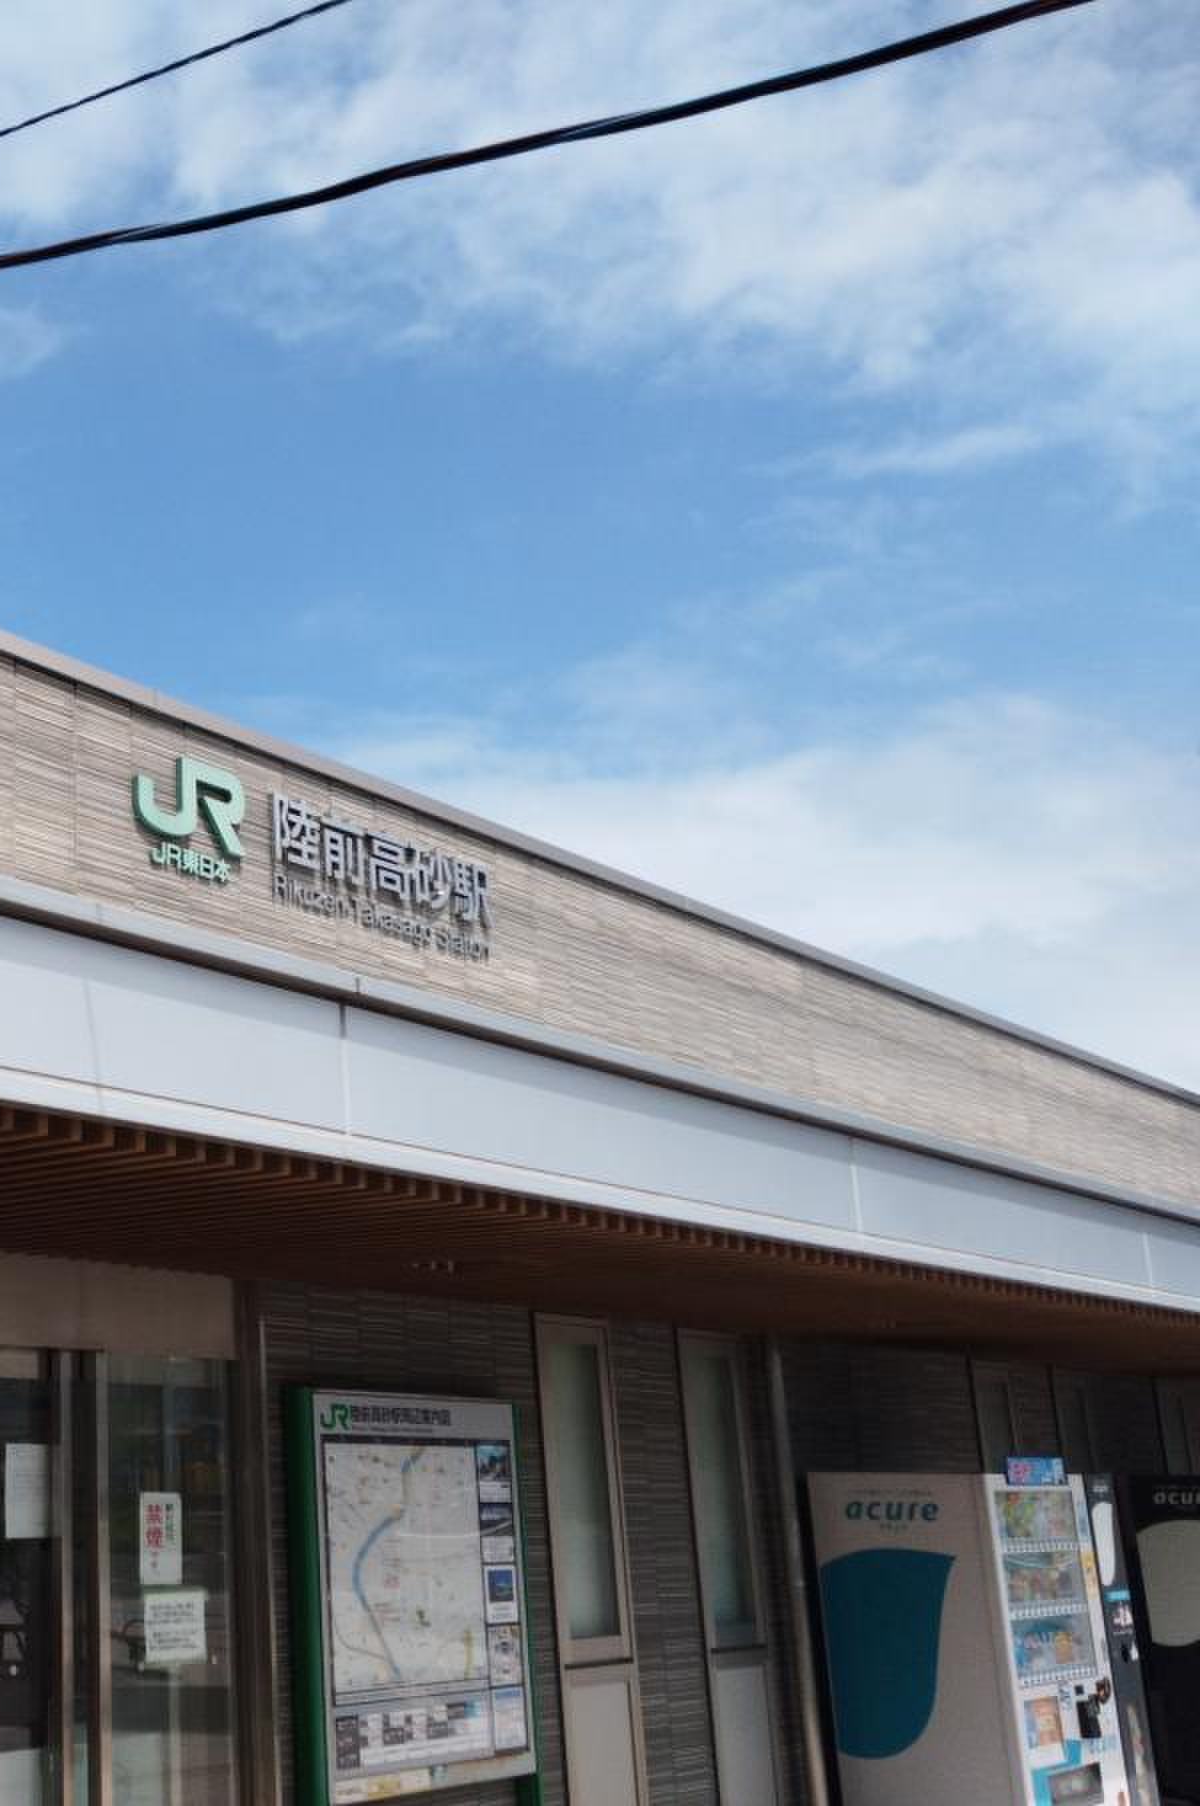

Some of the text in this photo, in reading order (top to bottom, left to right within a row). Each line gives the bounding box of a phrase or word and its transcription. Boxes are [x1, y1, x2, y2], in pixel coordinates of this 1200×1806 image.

[133, 756, 244, 858] JR
[149, 844, 234, 884] JR東日本
[272, 793, 494, 929] 陸前高砂駅
[320, 1403, 349, 1431] JR
[846, 1500, 939, 1522] acure
